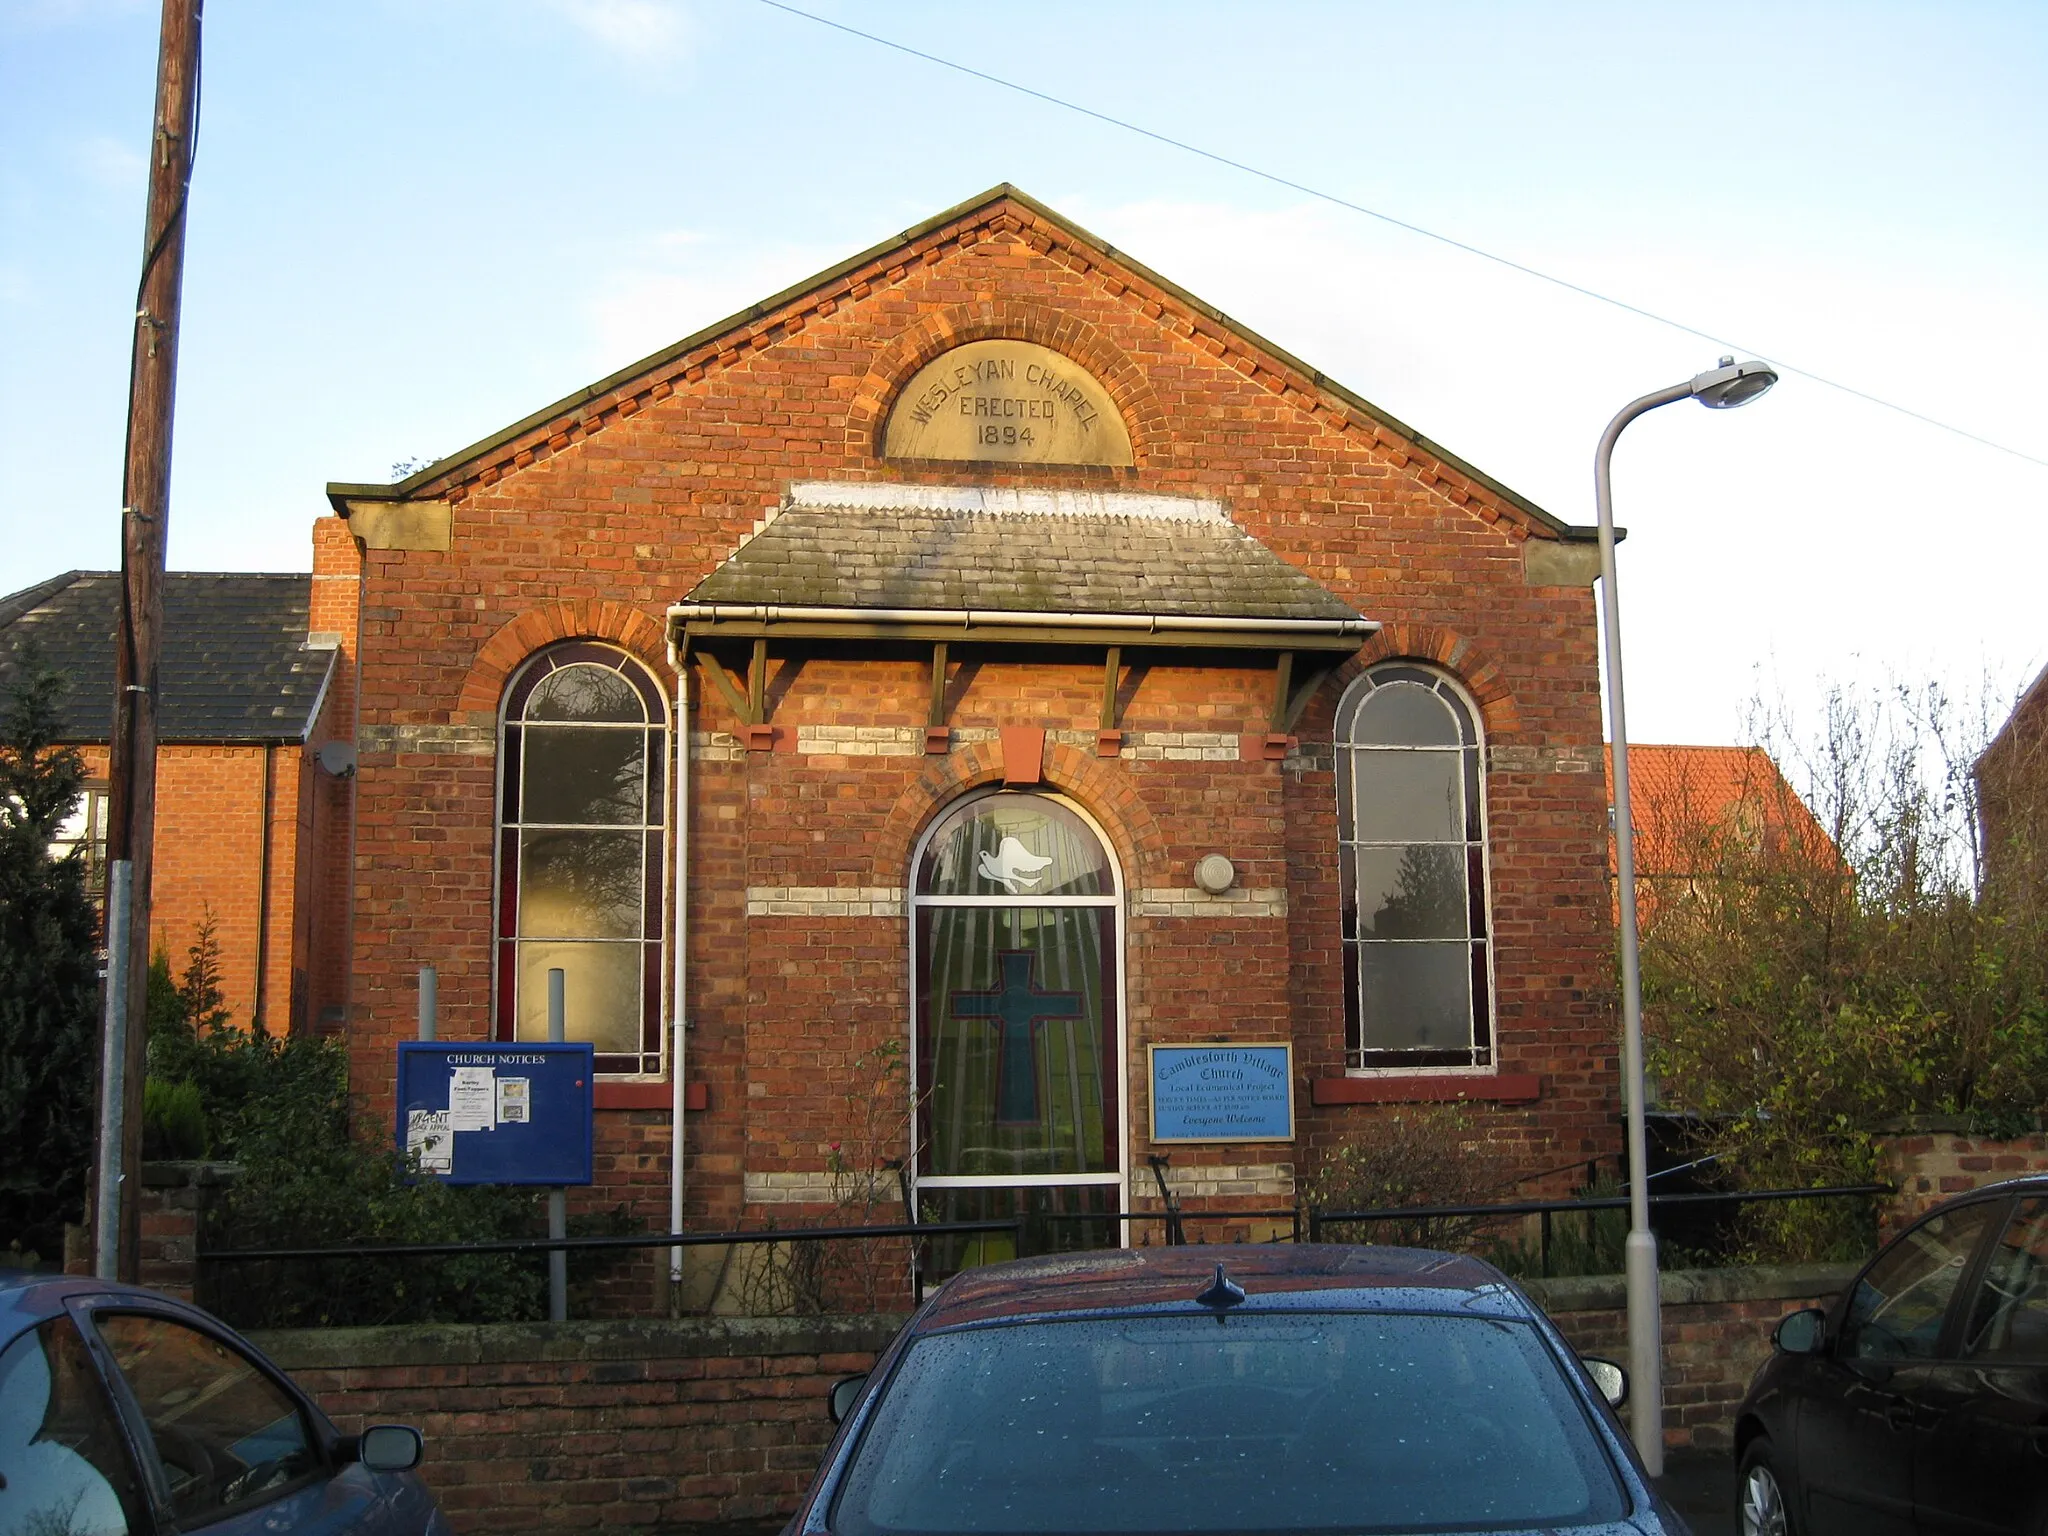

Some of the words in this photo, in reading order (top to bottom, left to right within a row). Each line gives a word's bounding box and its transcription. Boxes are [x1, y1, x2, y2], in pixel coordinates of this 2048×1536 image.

[909, 360, 1015, 426] WESLEYAN
[1026, 363, 1101, 432] CHAPEL
[960, 397, 1054, 418] ERECTED
[978, 425, 1035, 446] 1894
[447, 1055, 495, 1064] CHURCH
[499, 1055, 545, 1064] NOTICES
[1158, 1051, 1238, 1080] Camblesforth
[1243, 1052, 1283, 1079] Village
[1200, 1068, 1244, 1080] Church
[1247, 1084, 1275, 1092] Project
[411, 1112, 450, 1124] URGENT
[1183, 1115, 1223, 1127] Everyone
[1226, 1114, 1266, 1124] Welcome
